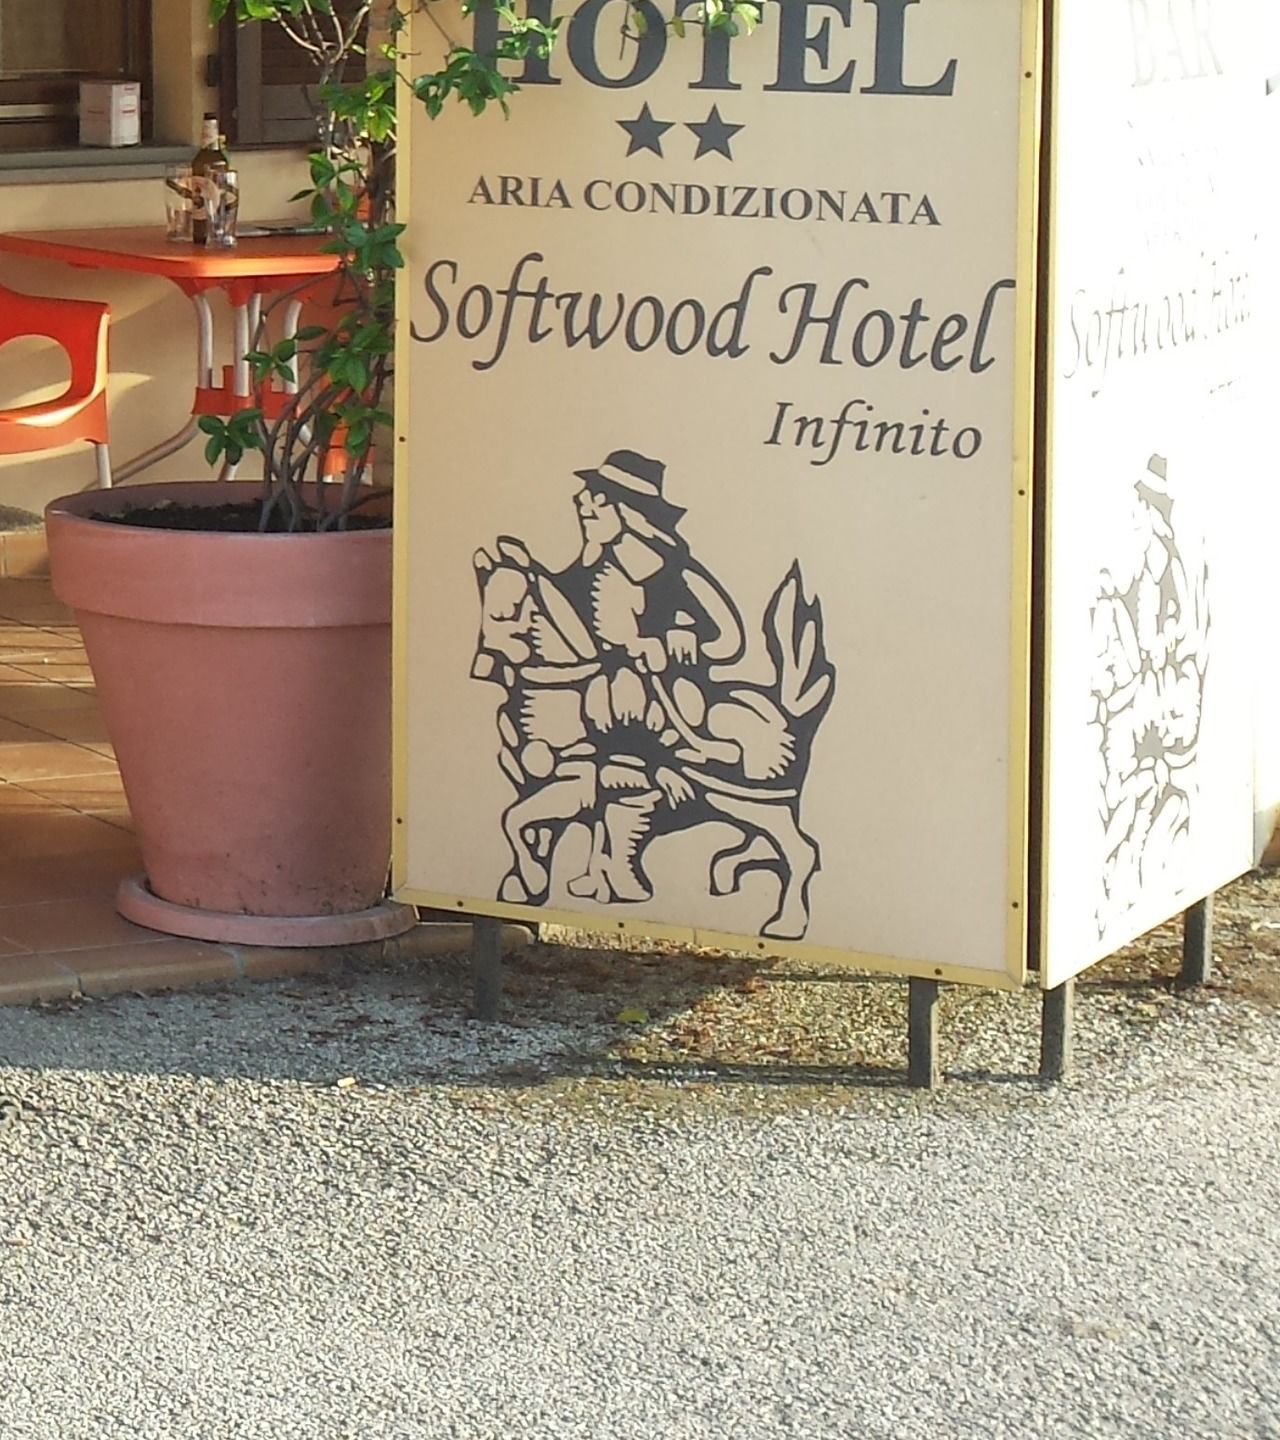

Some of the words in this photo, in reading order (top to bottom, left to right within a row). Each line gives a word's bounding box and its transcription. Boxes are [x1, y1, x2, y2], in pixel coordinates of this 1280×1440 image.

[466, 176, 572, 210] ARIA
[583, 178, 941, 227] CONDIZIONATA
[408, 251, 773, 372] Softwood
[768, 277, 1017, 375] Hotel
[763, 398, 982, 467] Infinito
